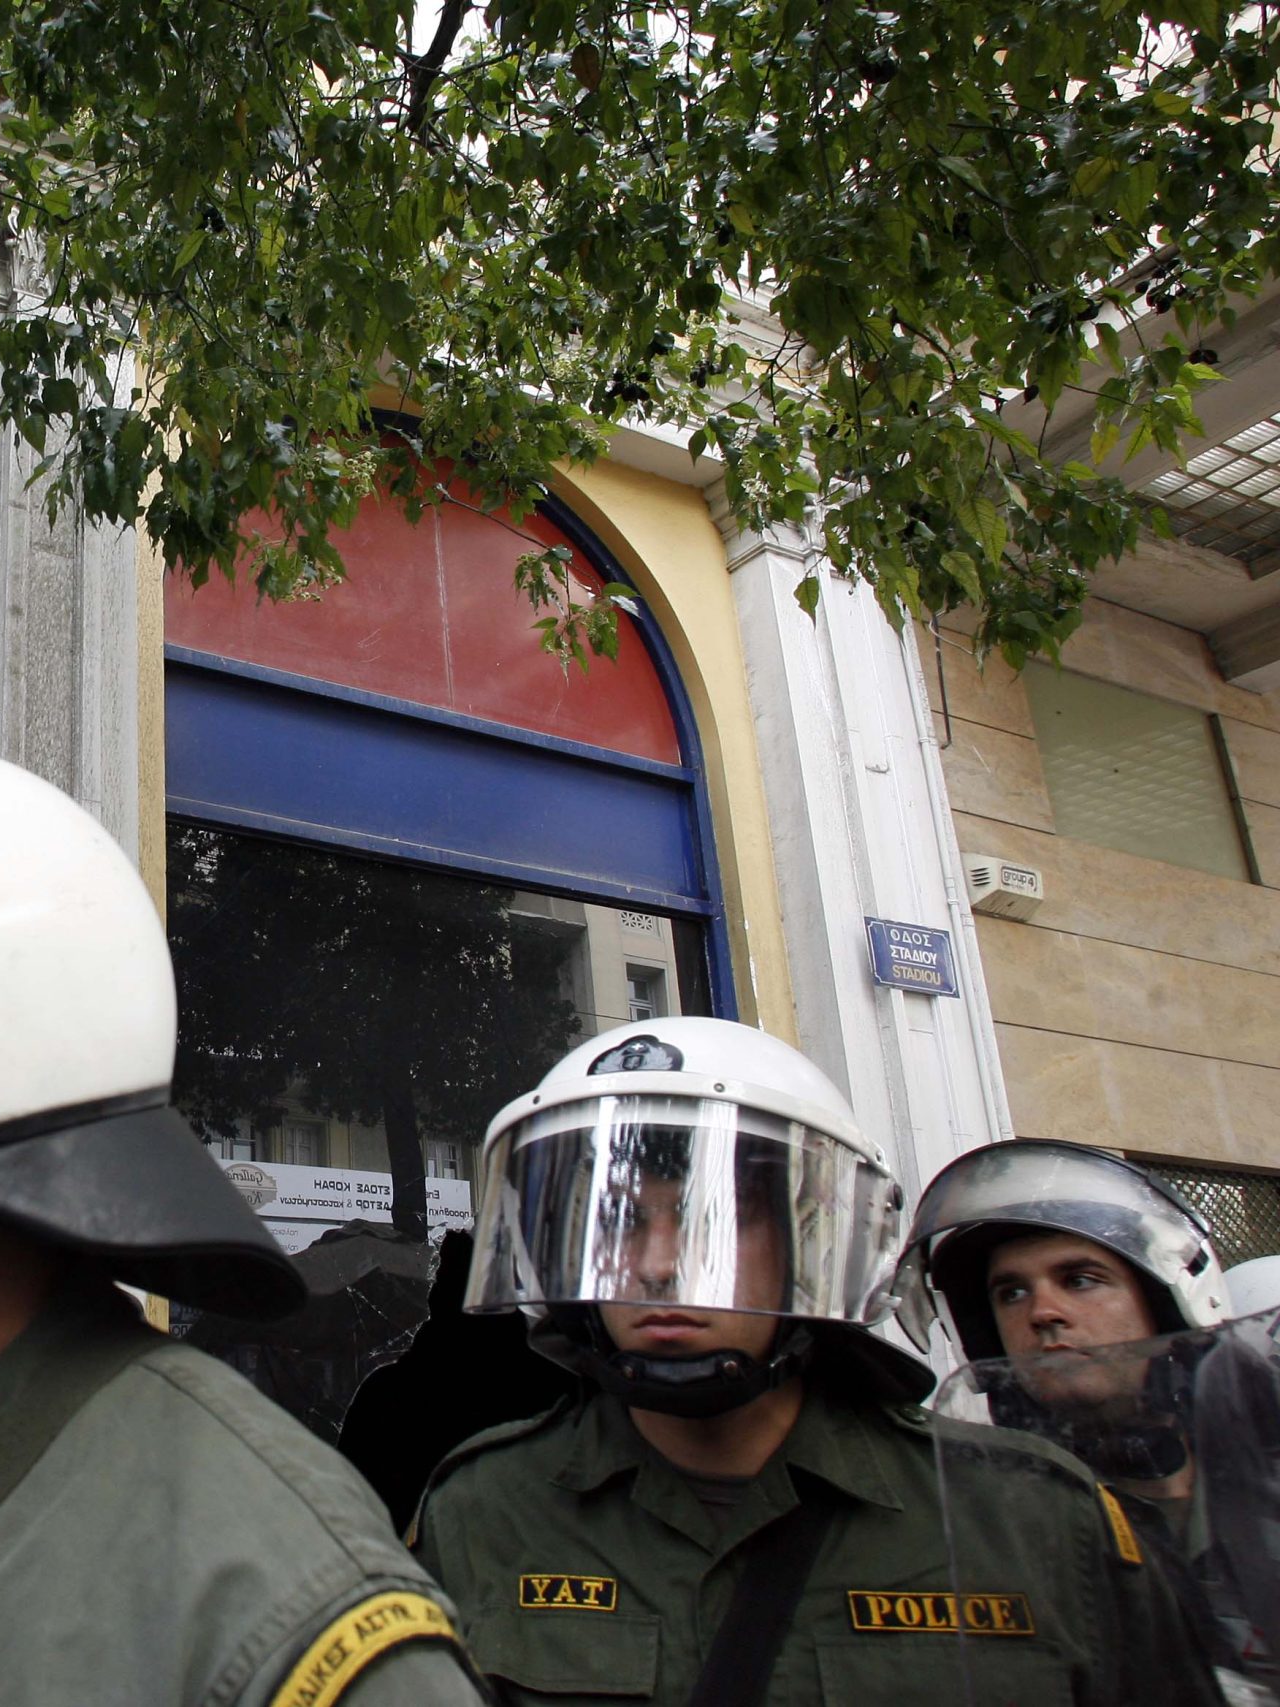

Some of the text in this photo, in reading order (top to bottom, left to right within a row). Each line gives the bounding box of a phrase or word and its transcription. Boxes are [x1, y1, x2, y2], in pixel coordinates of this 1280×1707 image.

[1003, 871, 1027, 885] group
[890, 929, 932, 947] ΟΔΟΣ
[889, 945, 937, 965] ΣΤΑΔΙΟΥ
[892, 965, 940, 985] STADIOU
[865, 1595, 1017, 1630] POLICE
